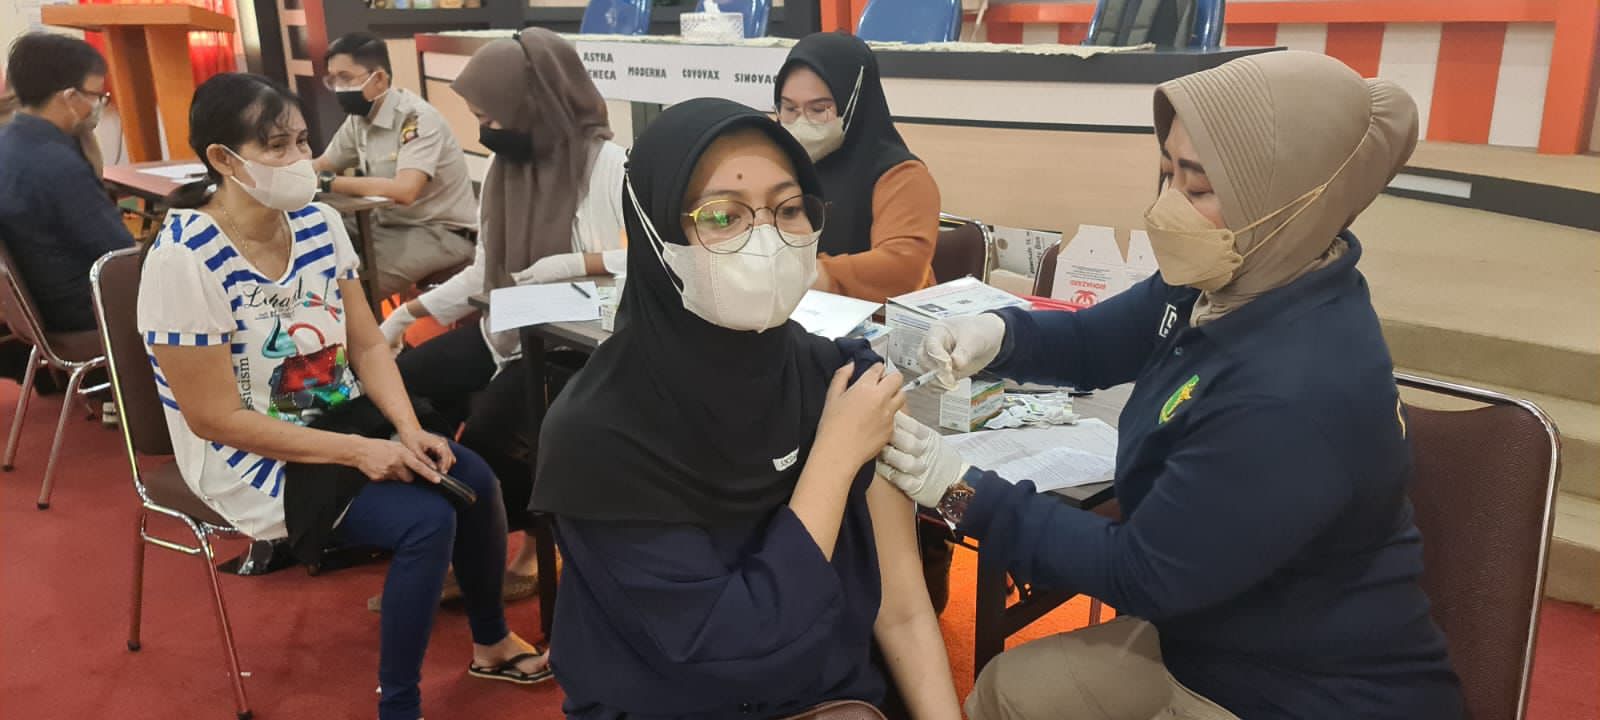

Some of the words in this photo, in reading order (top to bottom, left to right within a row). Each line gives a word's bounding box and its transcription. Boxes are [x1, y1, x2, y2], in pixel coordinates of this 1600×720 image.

[583, 52, 614, 63] ASTRA
[627, 67, 667, 79] MODERNA
[682, 69, 720, 80] COVOVAX
